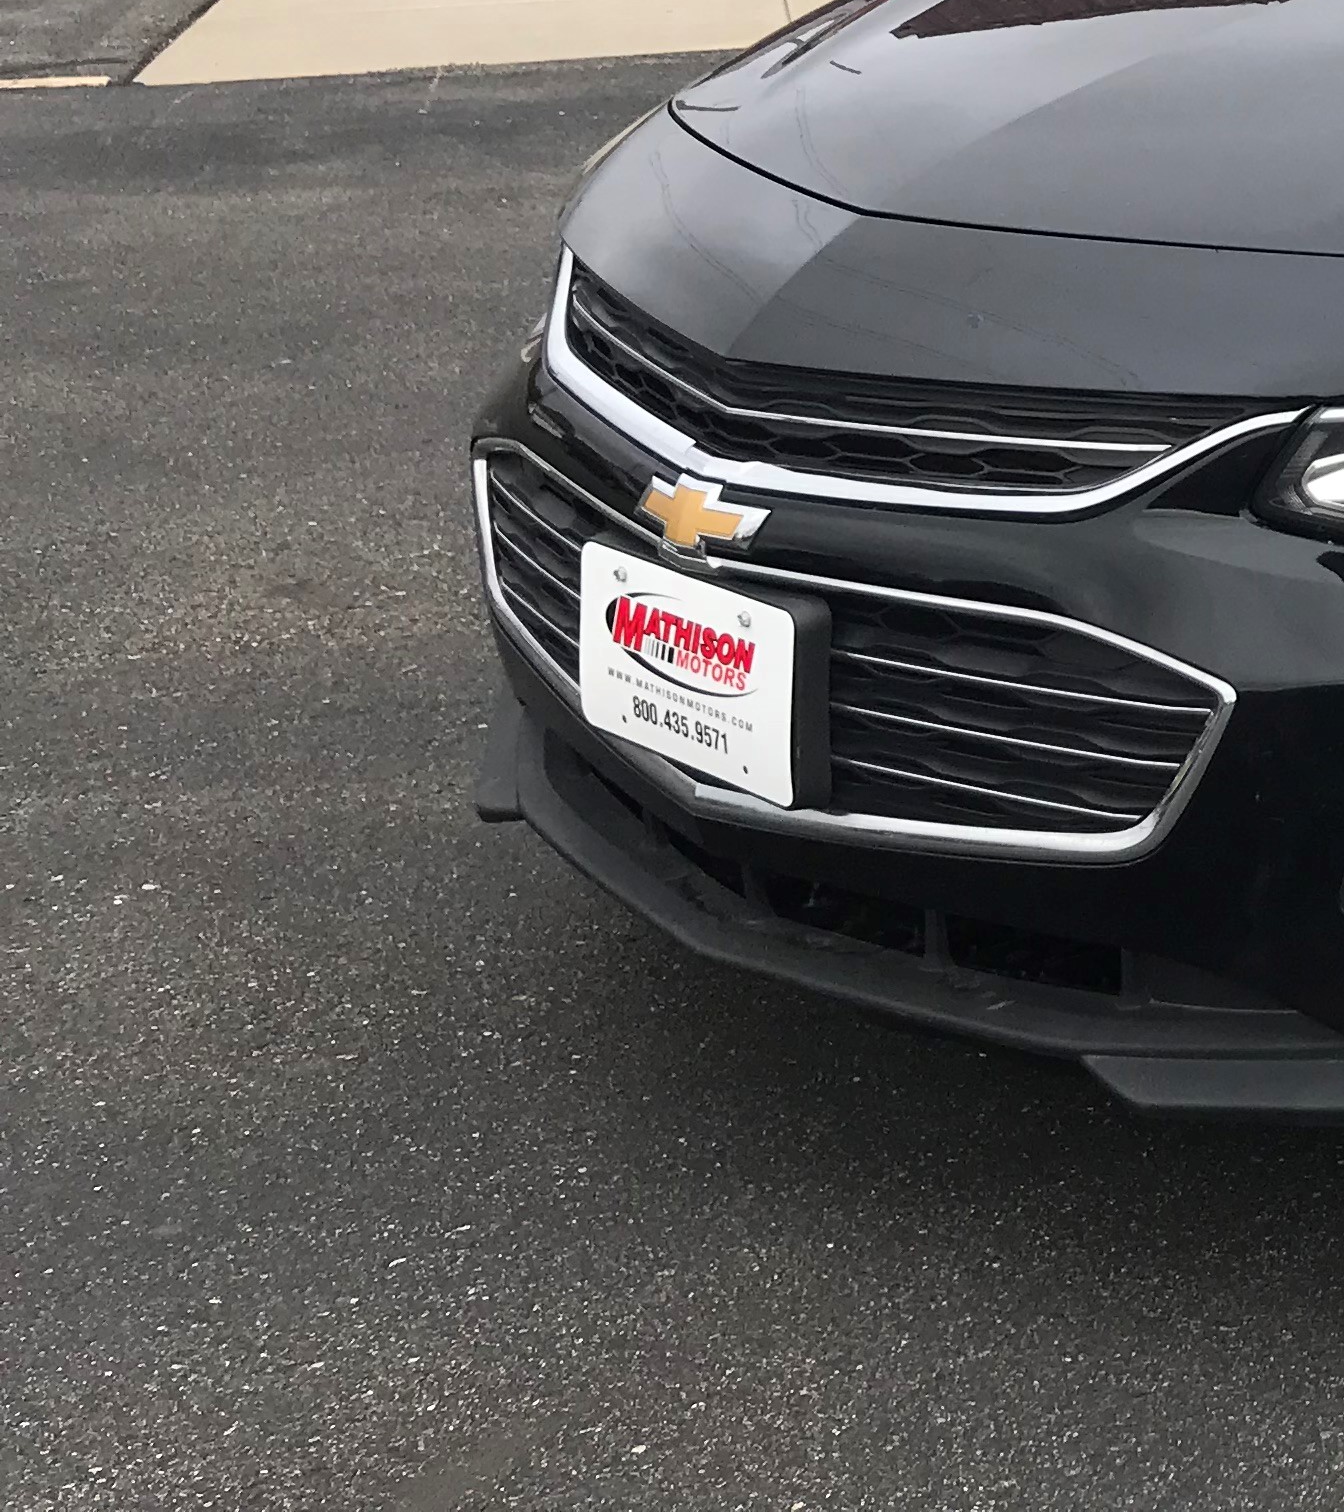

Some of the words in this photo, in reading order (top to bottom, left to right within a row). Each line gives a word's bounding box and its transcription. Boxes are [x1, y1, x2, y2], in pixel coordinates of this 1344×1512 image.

[612, 595, 755, 674] MATHISON
[607, 666, 753, 733] WWW.MATHISONMOTORS.COM
[676, 650, 747, 691] MOTORS
[632, 696, 728, 754] 800.435.9571
